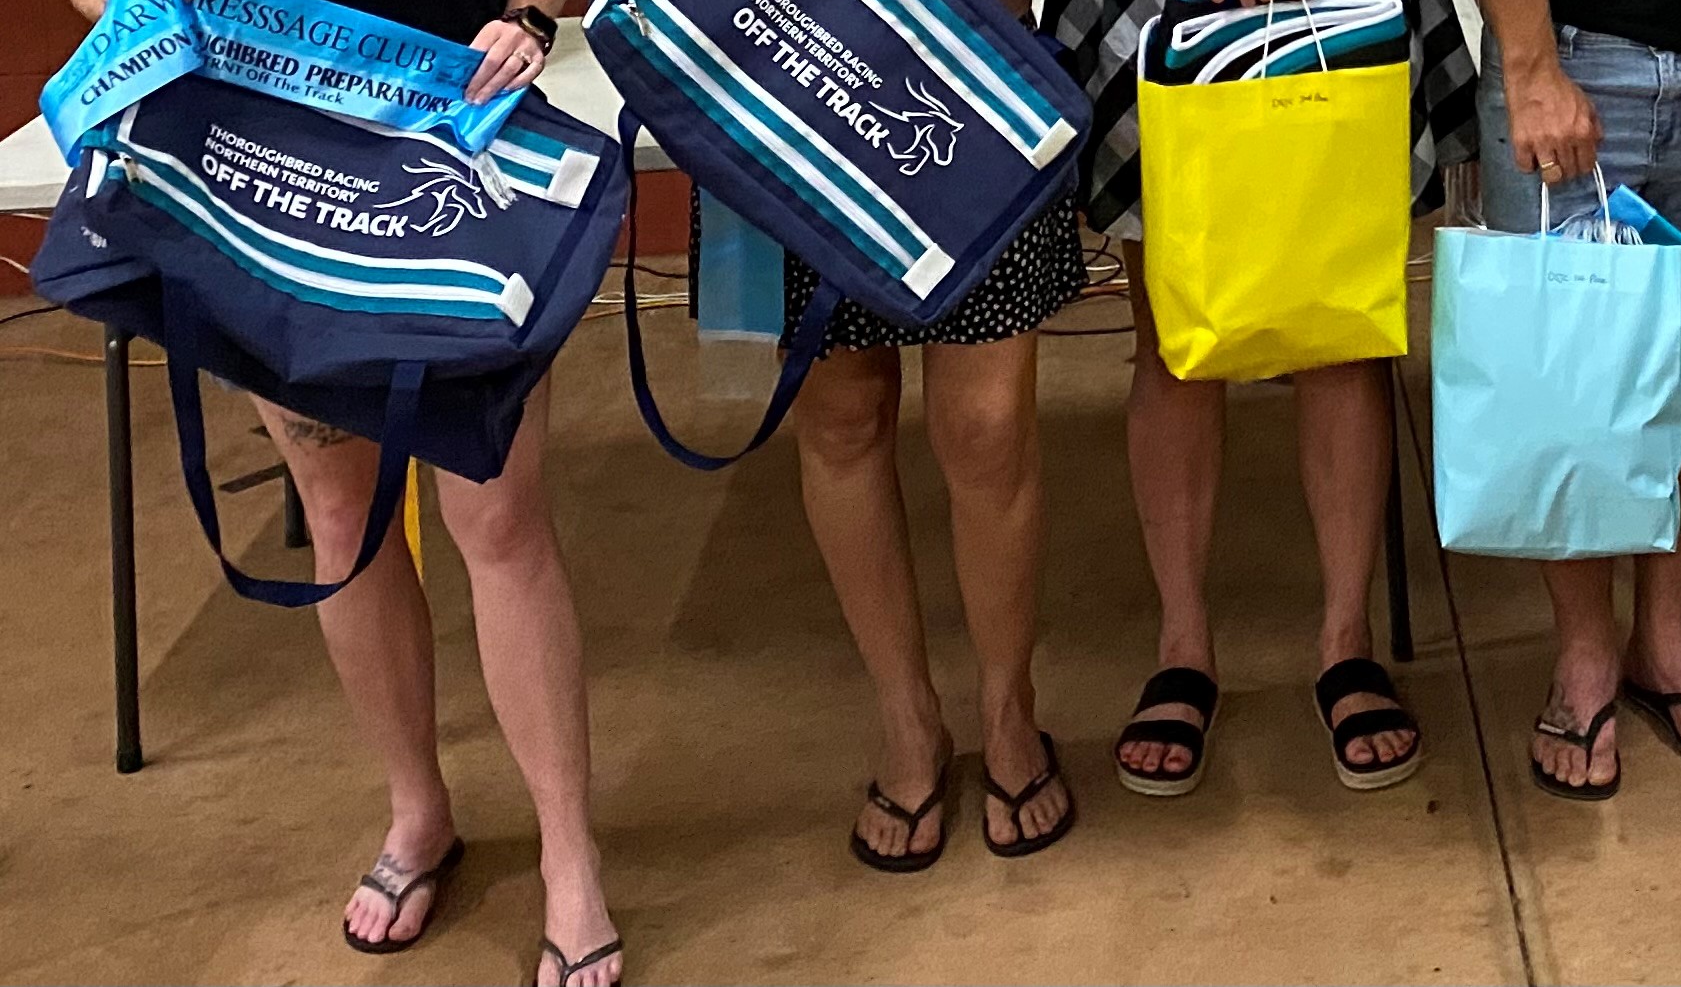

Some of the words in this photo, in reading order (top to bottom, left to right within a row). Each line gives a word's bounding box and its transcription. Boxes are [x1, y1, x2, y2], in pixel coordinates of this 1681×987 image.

[80, 29, 193, 106] CHAMPION
[304, 63, 453, 113] PREPARATORY
[357, 33, 438, 73] CLUB
[732, 7, 778, 47] OFF
[771, 40, 821, 88] THE
[815, 76, 890, 149] TRACK
[803, 35, 864, 90] TERRITORY
[839, 48, 883, 90] RACING
[246, 68, 270, 85] Off
[274, 76, 301, 95] The
[304, 84, 345, 106] Track
[205, 138, 280, 179] NORTHERN
[281, 172, 360, 203] TERRITORY
[209, 124, 322, 177] THOROUGHBRED
[323, 168, 381, 193] RACING
[201, 154, 250, 192] OFF
[253, 179, 313, 220] THE
[315, 201, 409, 237] TRACK
